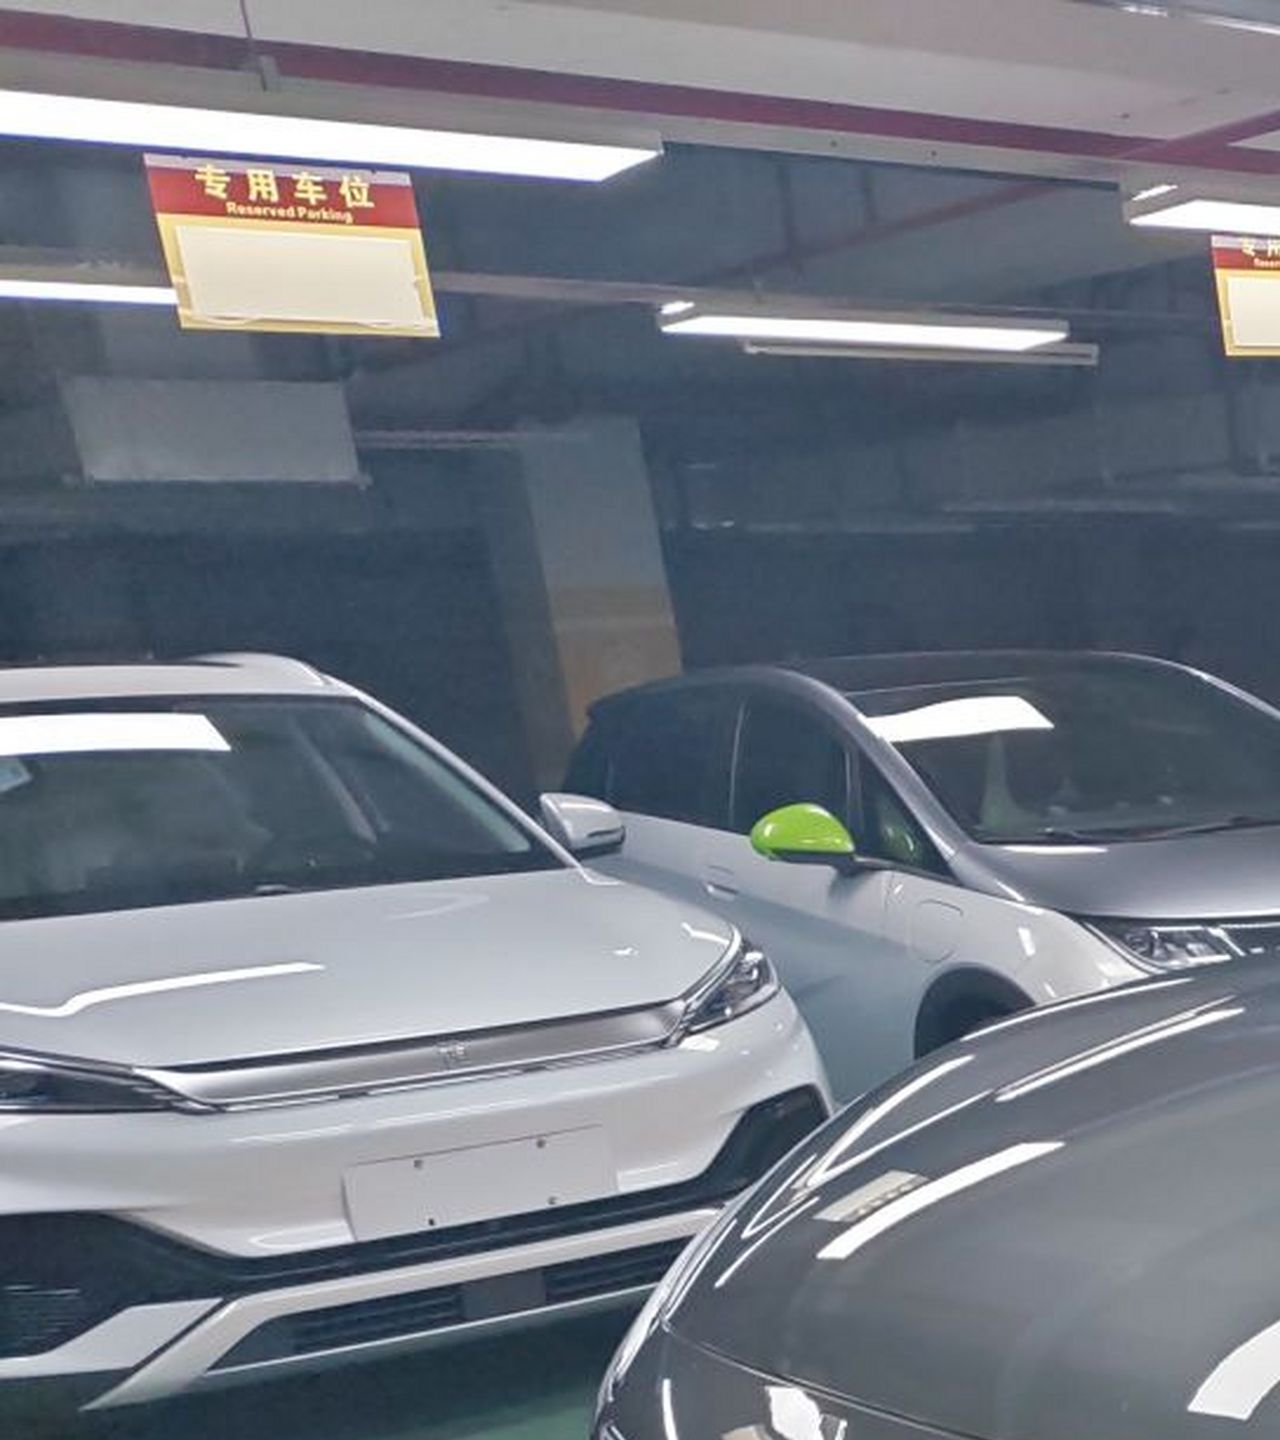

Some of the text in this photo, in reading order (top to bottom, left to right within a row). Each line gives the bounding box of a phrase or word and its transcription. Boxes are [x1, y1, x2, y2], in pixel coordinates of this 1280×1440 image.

[195, 164, 375, 208] 专用车位
[226, 202, 354, 224] Reserved Parking
